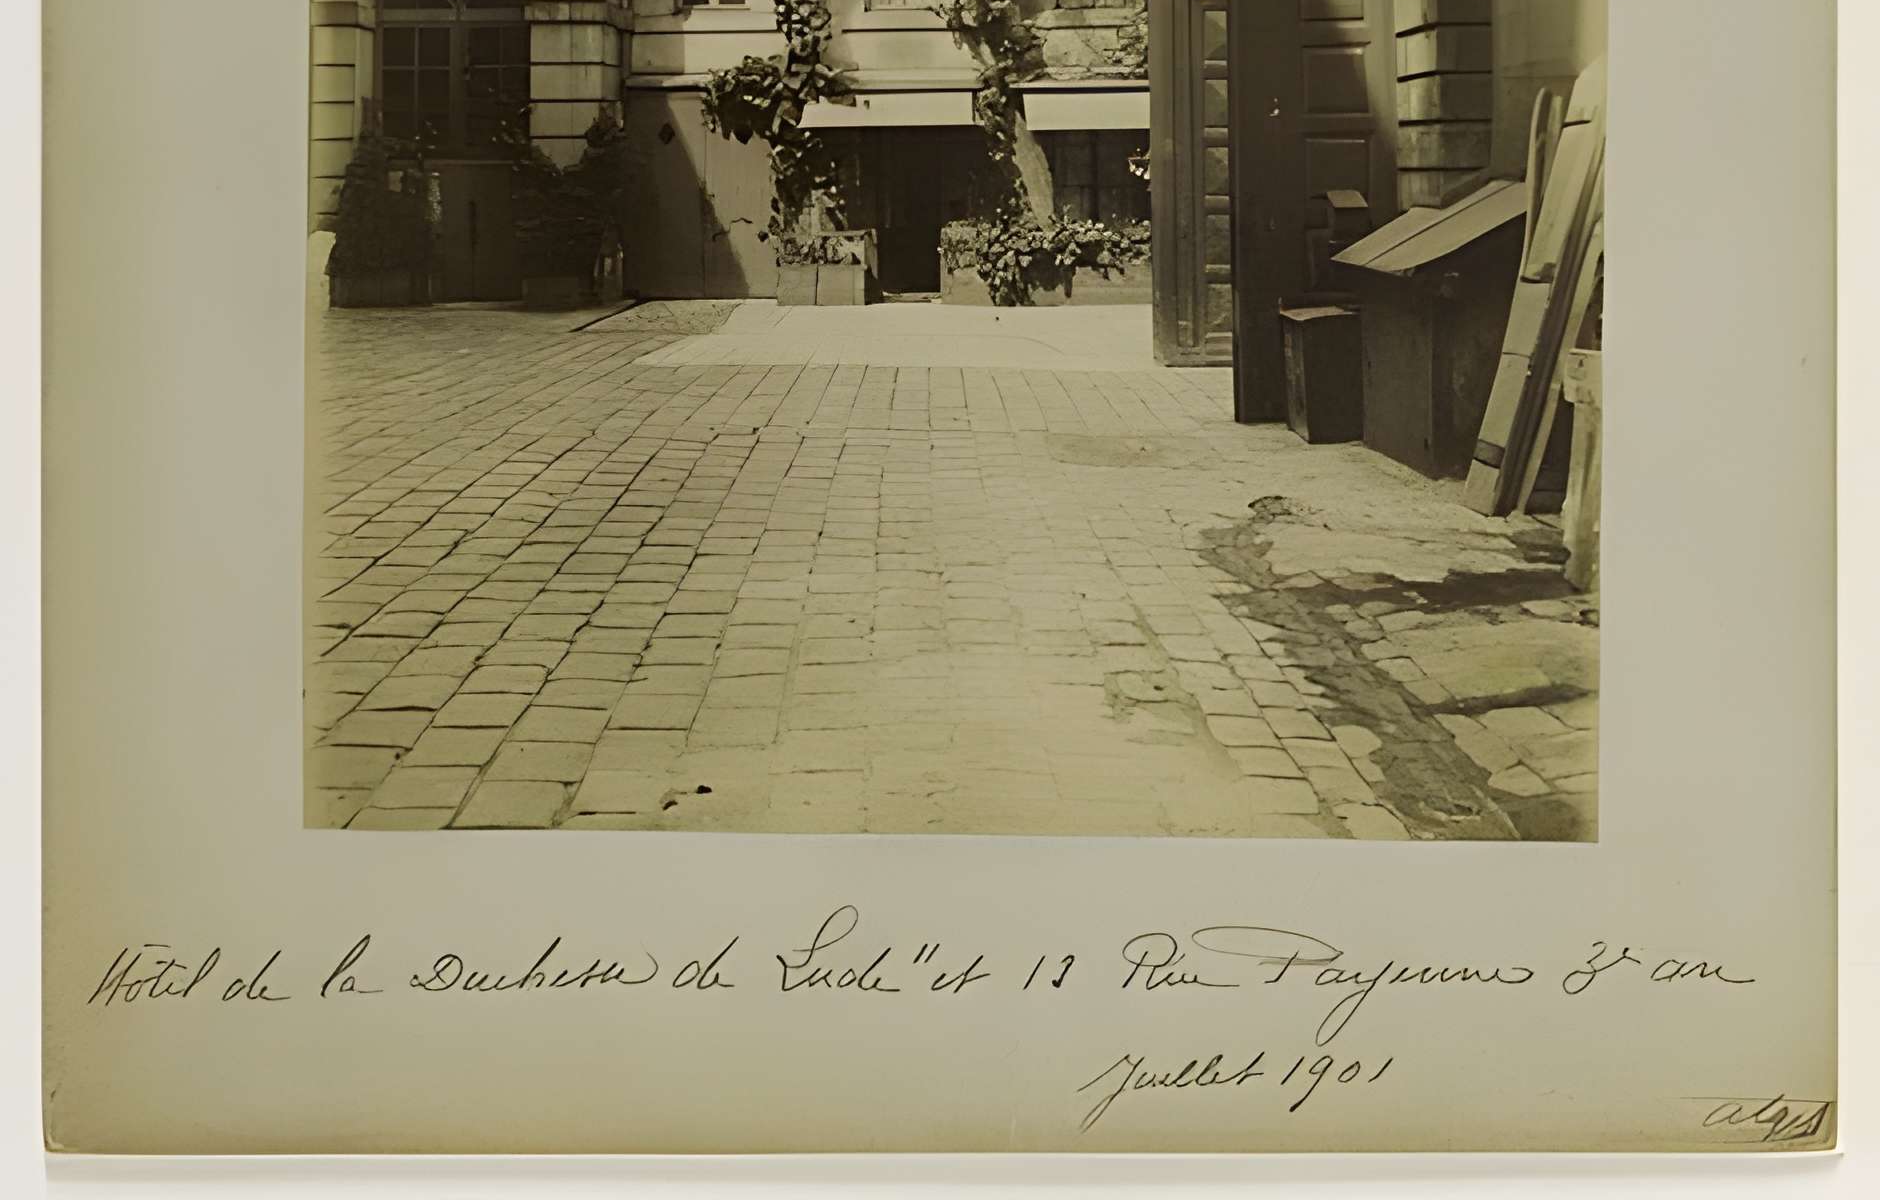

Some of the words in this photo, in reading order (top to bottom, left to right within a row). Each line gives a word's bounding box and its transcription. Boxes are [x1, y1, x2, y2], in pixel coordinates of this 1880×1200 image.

[88, 944, 222, 1007] Hôtel
[222, 950, 293, 1002] de
[319, 934, 383, 1000] la
[410, 936, 659, 991] Duchesse
[1077, 1051, 1265, 1134] Juillet
[1280, 1055, 1394, 1113] 1901
